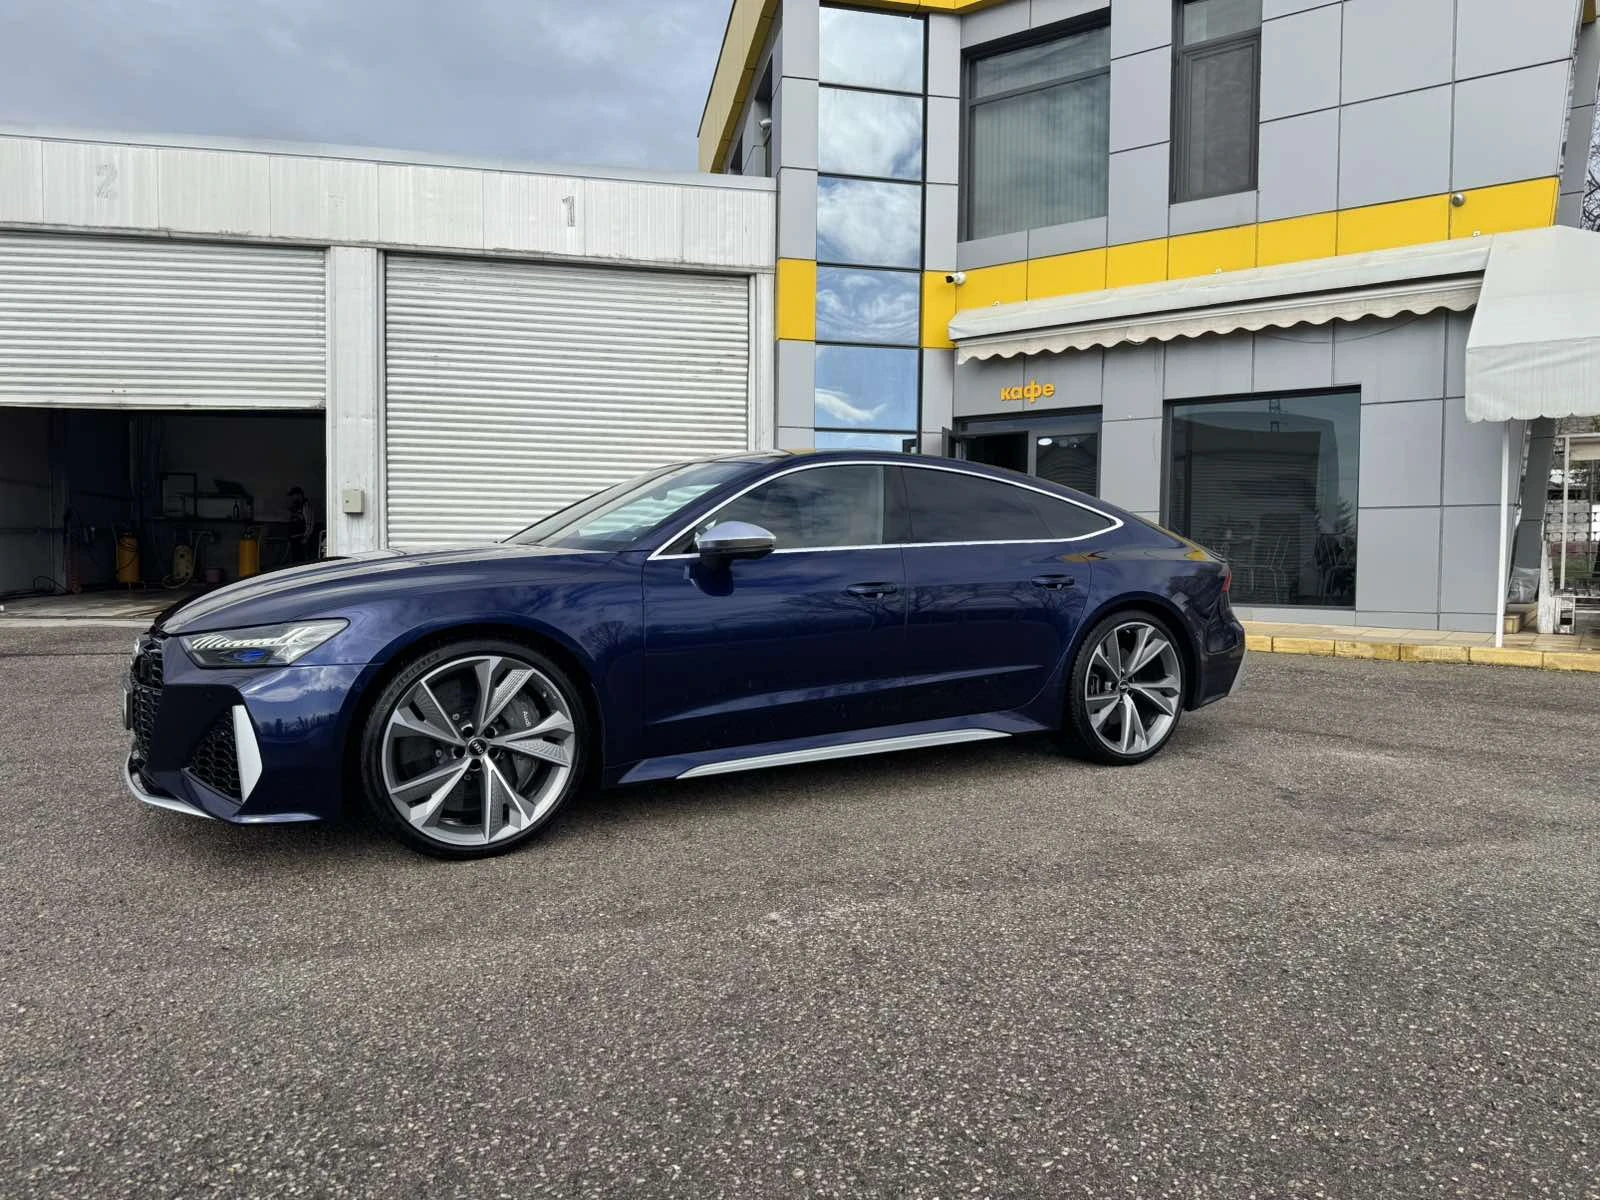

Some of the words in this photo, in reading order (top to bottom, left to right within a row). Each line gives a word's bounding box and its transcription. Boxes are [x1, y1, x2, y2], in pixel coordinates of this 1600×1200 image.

[96, 163, 118, 200] 2
[561, 195, 576, 228] 1
[1000, 380, 1055, 404] кафе
[522, 710, 532, 728] Audi
